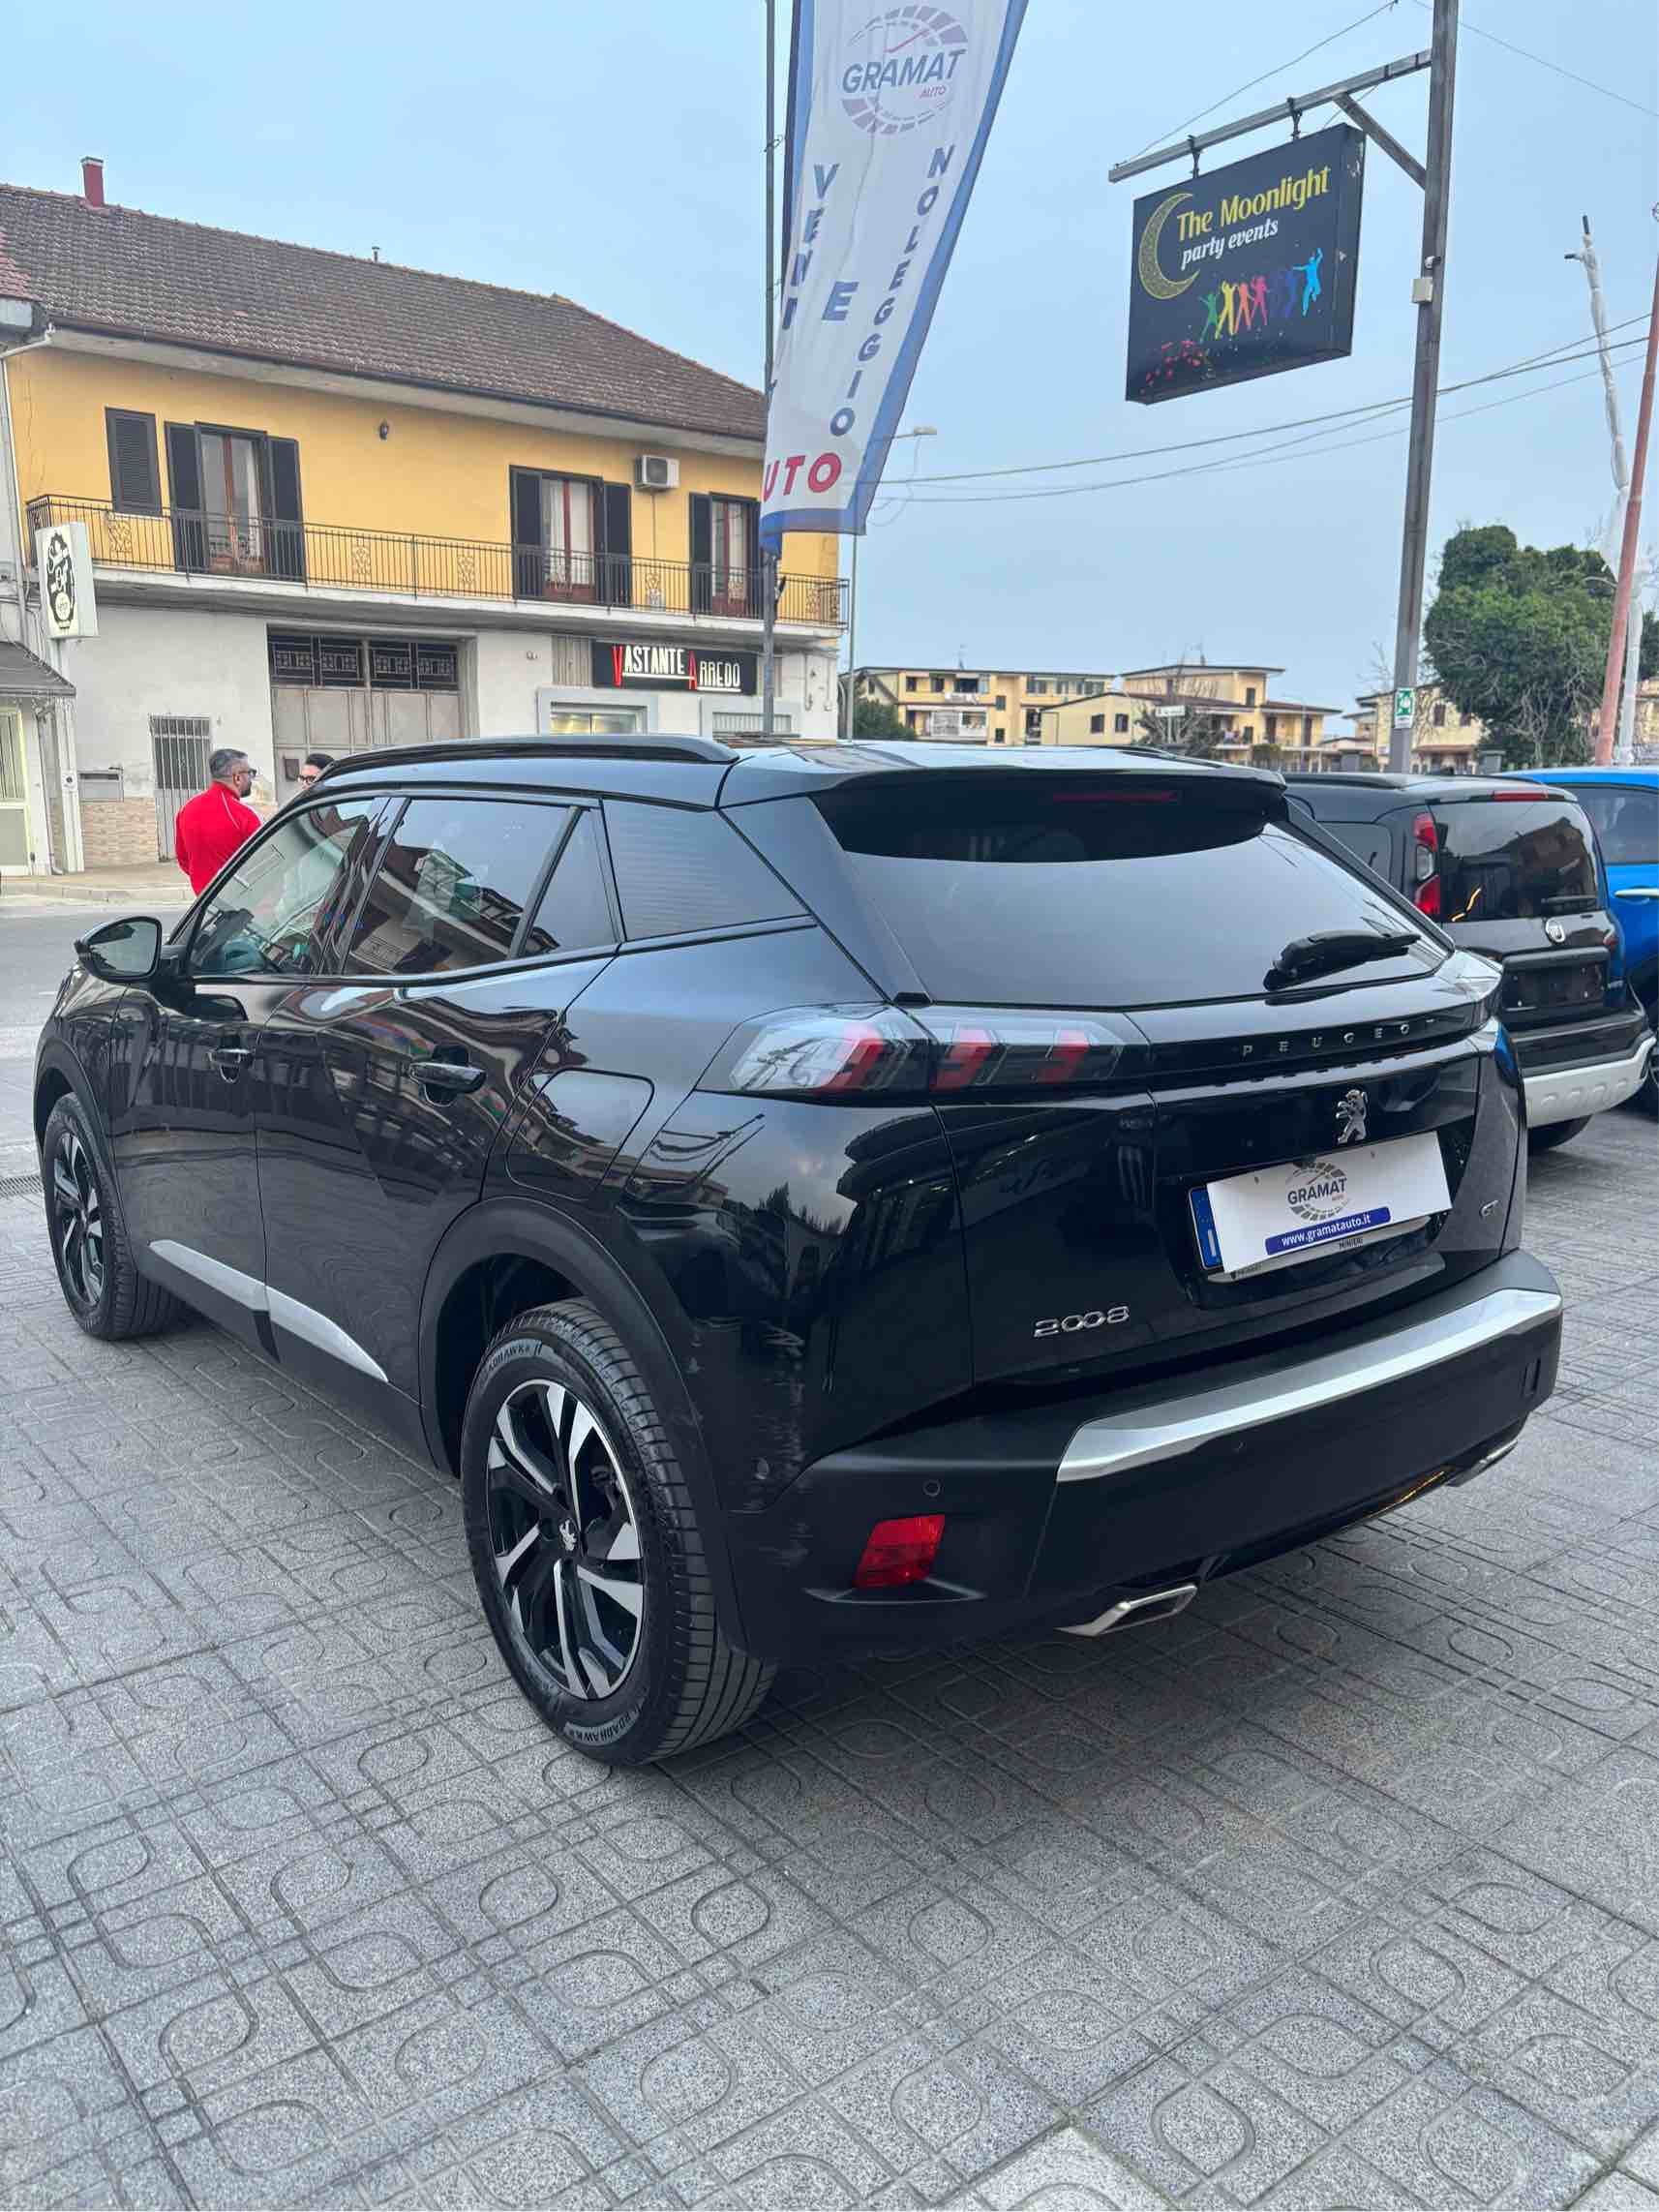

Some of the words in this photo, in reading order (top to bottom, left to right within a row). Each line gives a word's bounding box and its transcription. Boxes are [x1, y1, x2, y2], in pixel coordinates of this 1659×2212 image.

[842, 47, 968, 94] GRAMAT
[920, 84, 946, 98] AUTO
[1176, 209, 1214, 242] The
[1220, 166, 1332, 227] Moonlight
[1180, 235, 1226, 271] party
[1227, 217, 1279, 250] events
[822, 281, 860, 321] E
[830, 144, 955, 437] NOLEGGIO
[763, 451, 842, 503] UTO
[611, 645, 686, 689] VASTANTE
[688, 650, 741, 690] ARREDO
[1287, 1177, 1347, 1205] GRAMAT
[1281, 1213, 1372, 1247] www.gramatauto.it
[1034, 1305, 1130, 1338] 2008
